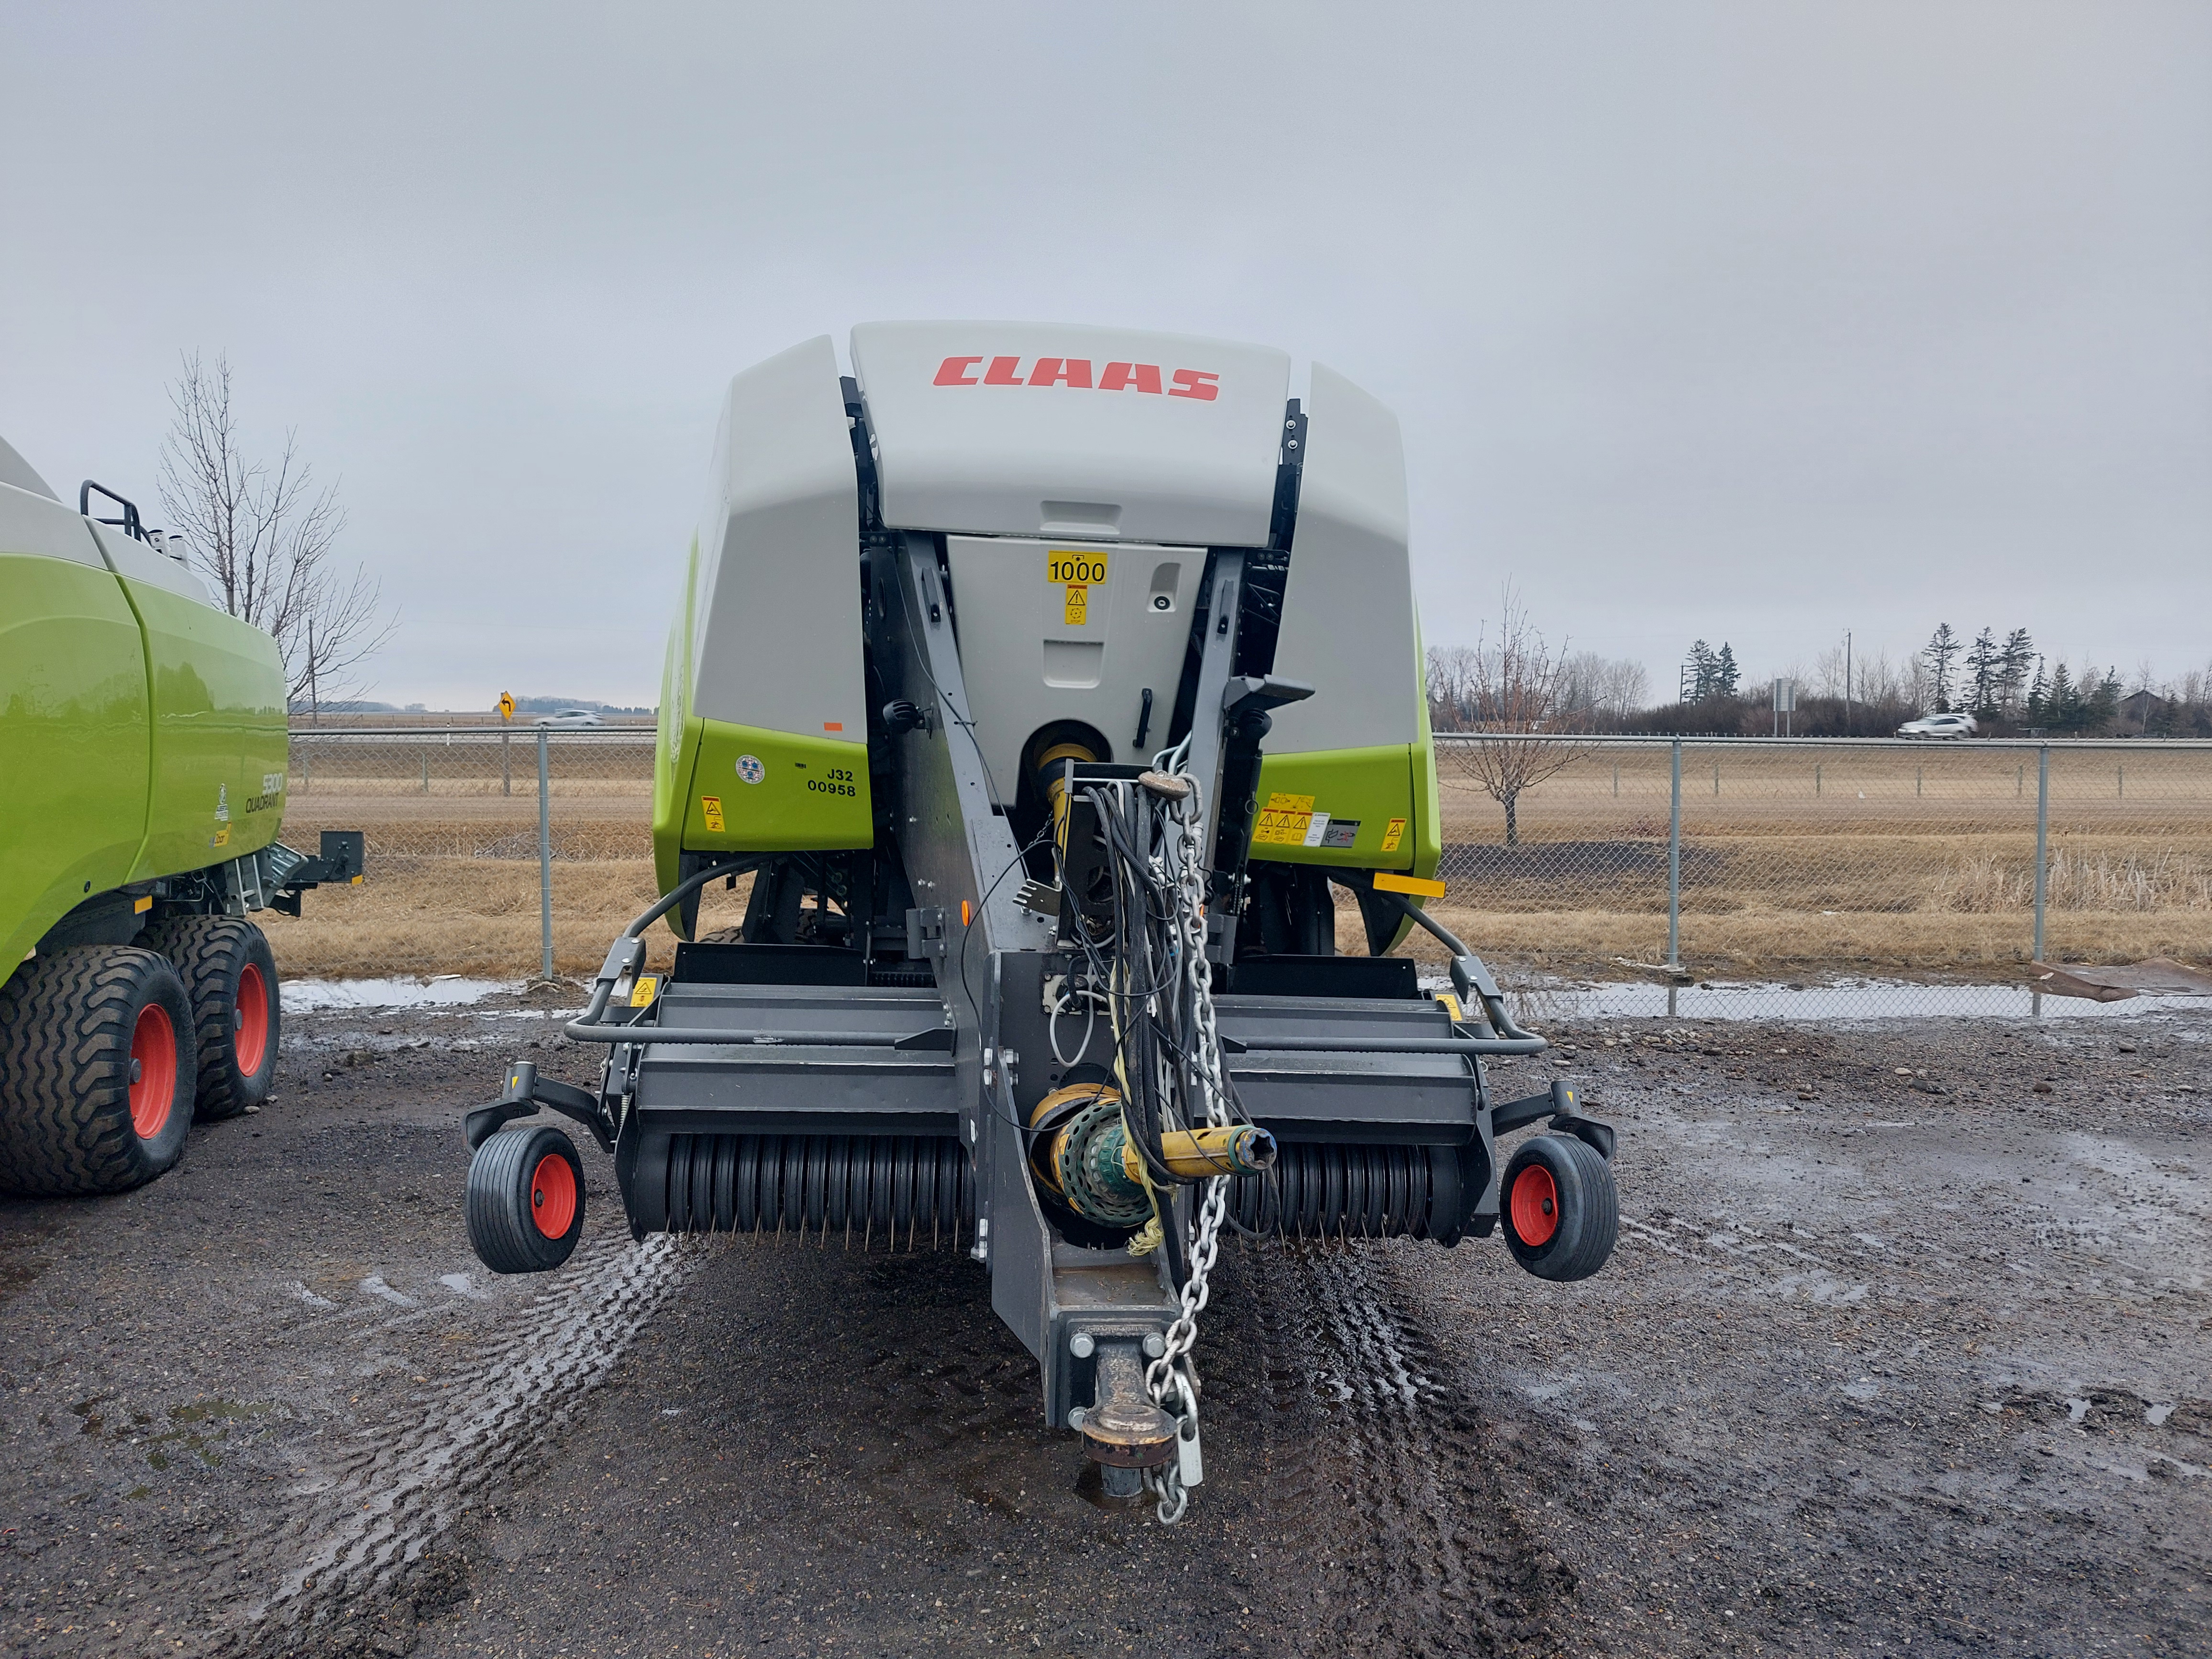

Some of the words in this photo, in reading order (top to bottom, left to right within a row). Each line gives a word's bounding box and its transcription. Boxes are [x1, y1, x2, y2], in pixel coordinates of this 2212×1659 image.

[933, 356, 1219, 401] CLAAS
[1050, 561, 1105, 582] 1000
[263, 772, 283, 795] 5300
[827, 768, 853, 782] J32
[807, 780, 856, 796] 00958
[245, 792, 279, 814] QUADRANT
